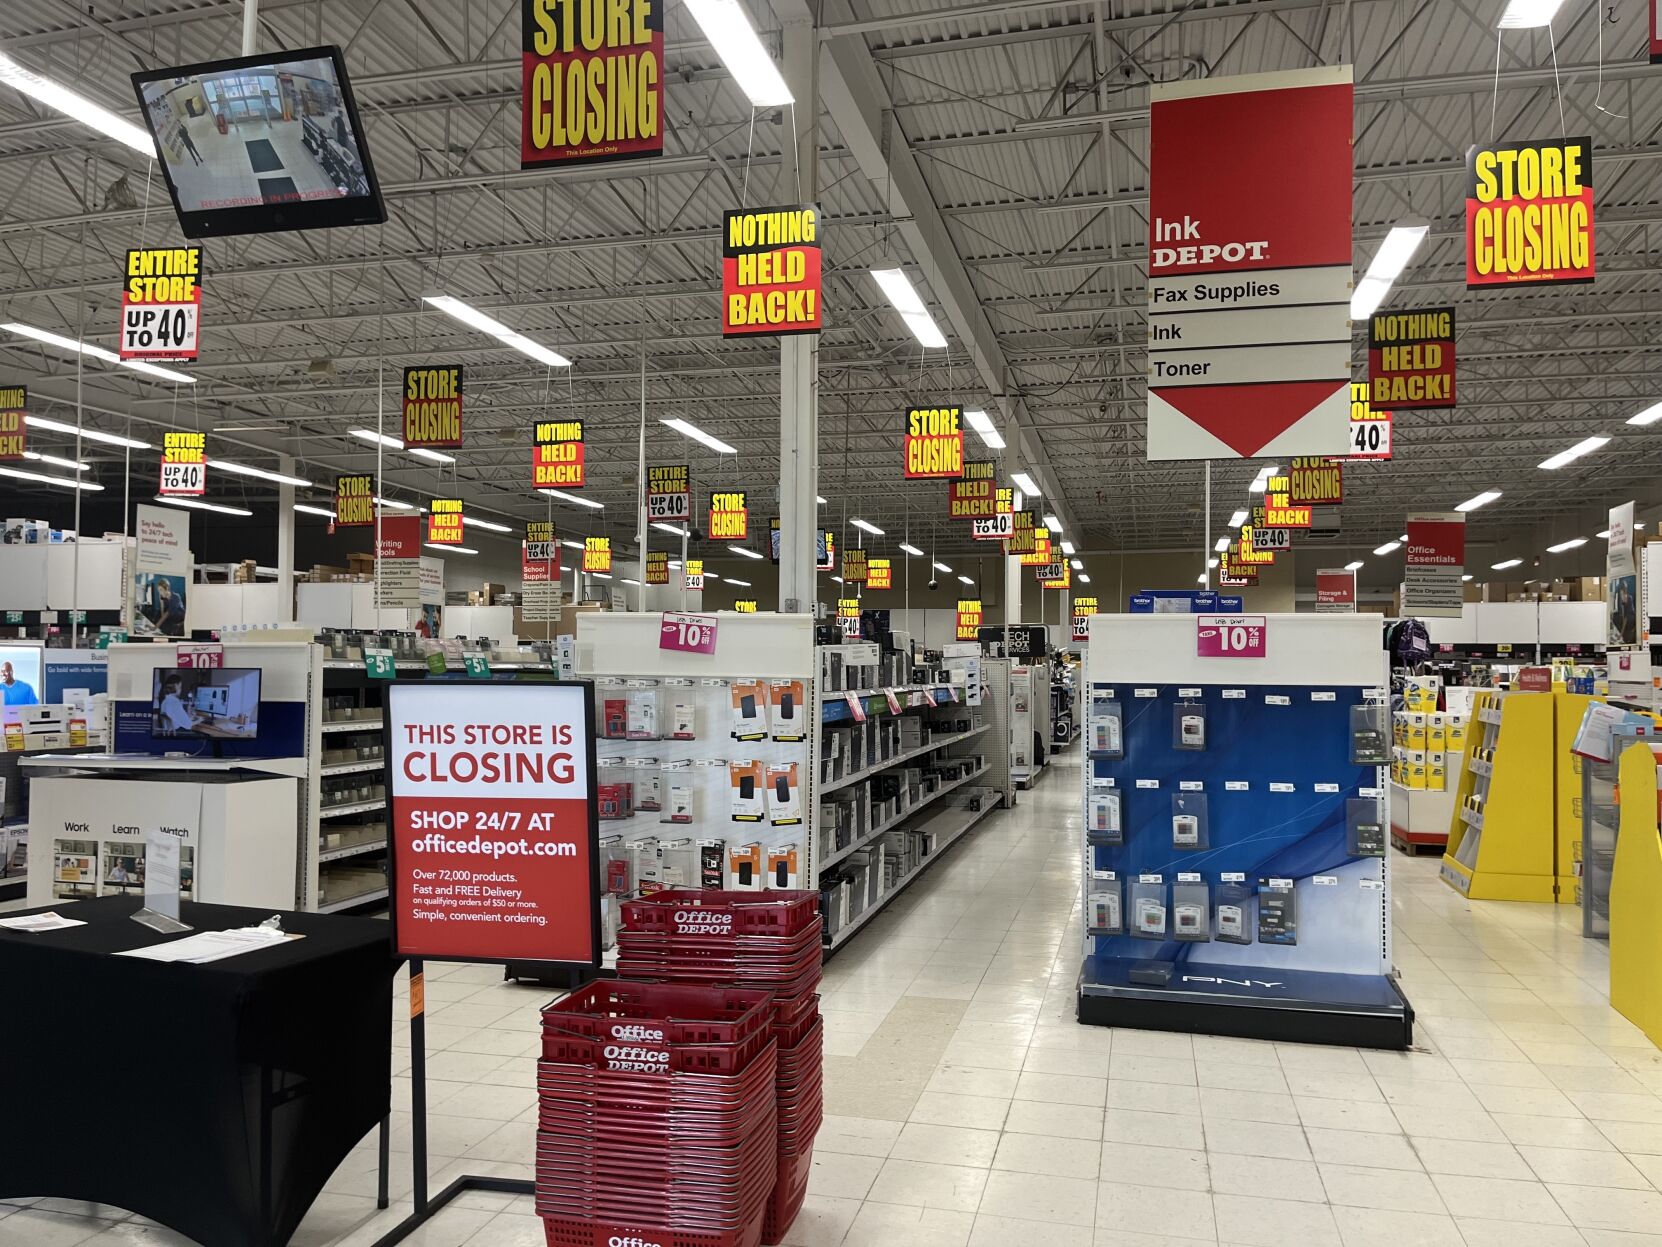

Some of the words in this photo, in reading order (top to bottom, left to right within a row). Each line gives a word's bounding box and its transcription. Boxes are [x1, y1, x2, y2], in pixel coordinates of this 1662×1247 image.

[534, 0, 653, 57] STORE
[532, 51, 657, 150] CLOSING
[580, 147, 604, 156] Location
[1474, 145, 1582, 203] STORE
[729, 209, 815, 248] NOTHING
[1155, 215, 1200, 242] Ink
[1474, 199, 1589, 276] CLOSING
[1152, 240, 1268, 267] DEPOT
[128, 249, 198, 276] ENTIRE
[738, 250, 805, 287] HELD
[129, 276, 195, 302] STORE
[1153, 284, 1190, 304] Fax
[1194, 280, 1280, 303] Supplies
[729, 288, 815, 326] BACK!
[127, 310, 156, 328] UP
[1374, 311, 1450, 342] NOTHING
[126, 330, 152, 347] TO
[1152, 323, 1182, 341] Ink
[1382, 344, 1441, 371] HELD
[1153, 359, 1210, 378] Toner
[407, 369, 458, 400] STORE
[1374, 372, 1450, 402] BACK!
[406, 402, 460, 442] CLOSING
[910, 408, 959, 437] STORE
[537, 422, 581, 442] NOTHING
[164, 432, 206, 448] ENTIRE
[164, 448, 204, 464] STORE
[541, 444, 576, 463] HELD
[909, 437, 960, 474] CLOSING
[164, 466, 181, 476] UP
[536, 464, 581, 484] BACK!
[650, 466, 688, 480] ENTIRE
[164, 478, 180, 488] TO
[338, 477, 371, 496] STORE
[650, 480, 687, 494] STORE
[956, 481, 989, 498] HELD
[1292, 470, 1340, 500] CLOSING
[432, 500, 462, 512] NOTHING
[651, 496, 666, 506] UP
[712, 494, 745, 512] STORE
[952, 499, 994, 516] BACK!
[338, 496, 372, 522] CLOSING
[651, 506, 666, 516] TO
[434, 514, 458, 526] HELD
[712, 512, 746, 537] CLOSING
[1015, 512, 1033, 528] ORE
[1268, 510, 1308, 524] BACK!
[430, 528, 462, 541] BACK!
[527, 522, 554, 532] ENTIRE
[976, 526, 990, 534] TO
[528, 532, 554, 542] STORE
[1254, 538, 1268, 546] TO
[586, 538, 610, 552] STORE
[1408, 546, 1436, 554] Office
[585, 552, 610, 570] CLOSING
[844, 550, 866, 562] STORE
[1020, 553, 1048, 564] BACK!
[1408, 554, 1456, 562] Essentials
[648, 562, 664, 572] HELD
[843, 562, 867, 580] CLOSING
[868, 560, 890, 568] NOTHING
[1228, 566, 1257, 576] BACK!
[646, 572, 668, 582] BACK!
[870, 568, 888, 578] HELD
[868, 579, 890, 587] BACK!
[838, 599, 859, 607] ENTIRE
[958, 600, 982, 612] NOTHING
[1074, 598, 1098, 606] ENTIRE
[838, 608, 859, 616] STORE
[1075, 607, 1098, 616] STORE
[960, 614, 978, 625] HELD
[1074, 618, 1086, 626] UP
[1001, 632, 1030, 640] TECH
[1074, 626, 1084, 634] TO
[404, 724, 456, 744] THIS
[464, 725, 542, 745] STORE
[552, 726, 572, 746] IS
[403, 752, 576, 784] CLOSING
[65, 822, 89, 832] Work
[410, 810, 470, 830] SHOP
[475, 812, 522, 832] 24/7
[528, 813, 554, 831] AT
[112, 824, 140, 834] Learn
[412, 834, 576, 860] officedepot.com
[413, 870, 436, 880] Over
[438, 870, 470, 882] 72,000
[472, 872, 518, 884] products.
[413, 884, 432, 894] Fast
[434, 884, 452, 895] and
[455, 886, 480, 896] FREE
[483, 886, 522, 900] Delivery
[424, 897, 458, 908] qualifying
[459, 898, 482, 907] orders
[483, 898, 492, 907] of
[492, 898, 506, 908] $50
[413, 910, 448, 922] Simple,
[450, 912, 502, 923] convenient
[504, 913, 548, 926] ordering.
[674, 910, 732, 924] Office
[677, 924, 732, 935] DEPOT
[1182, 976, 1283, 988] PNY
[611, 1025, 664, 1040] Office
[604, 1046, 670, 1062] Office
[607, 1060, 668, 1074] DEPOT
[609, 1236, 661, 1247] Office
